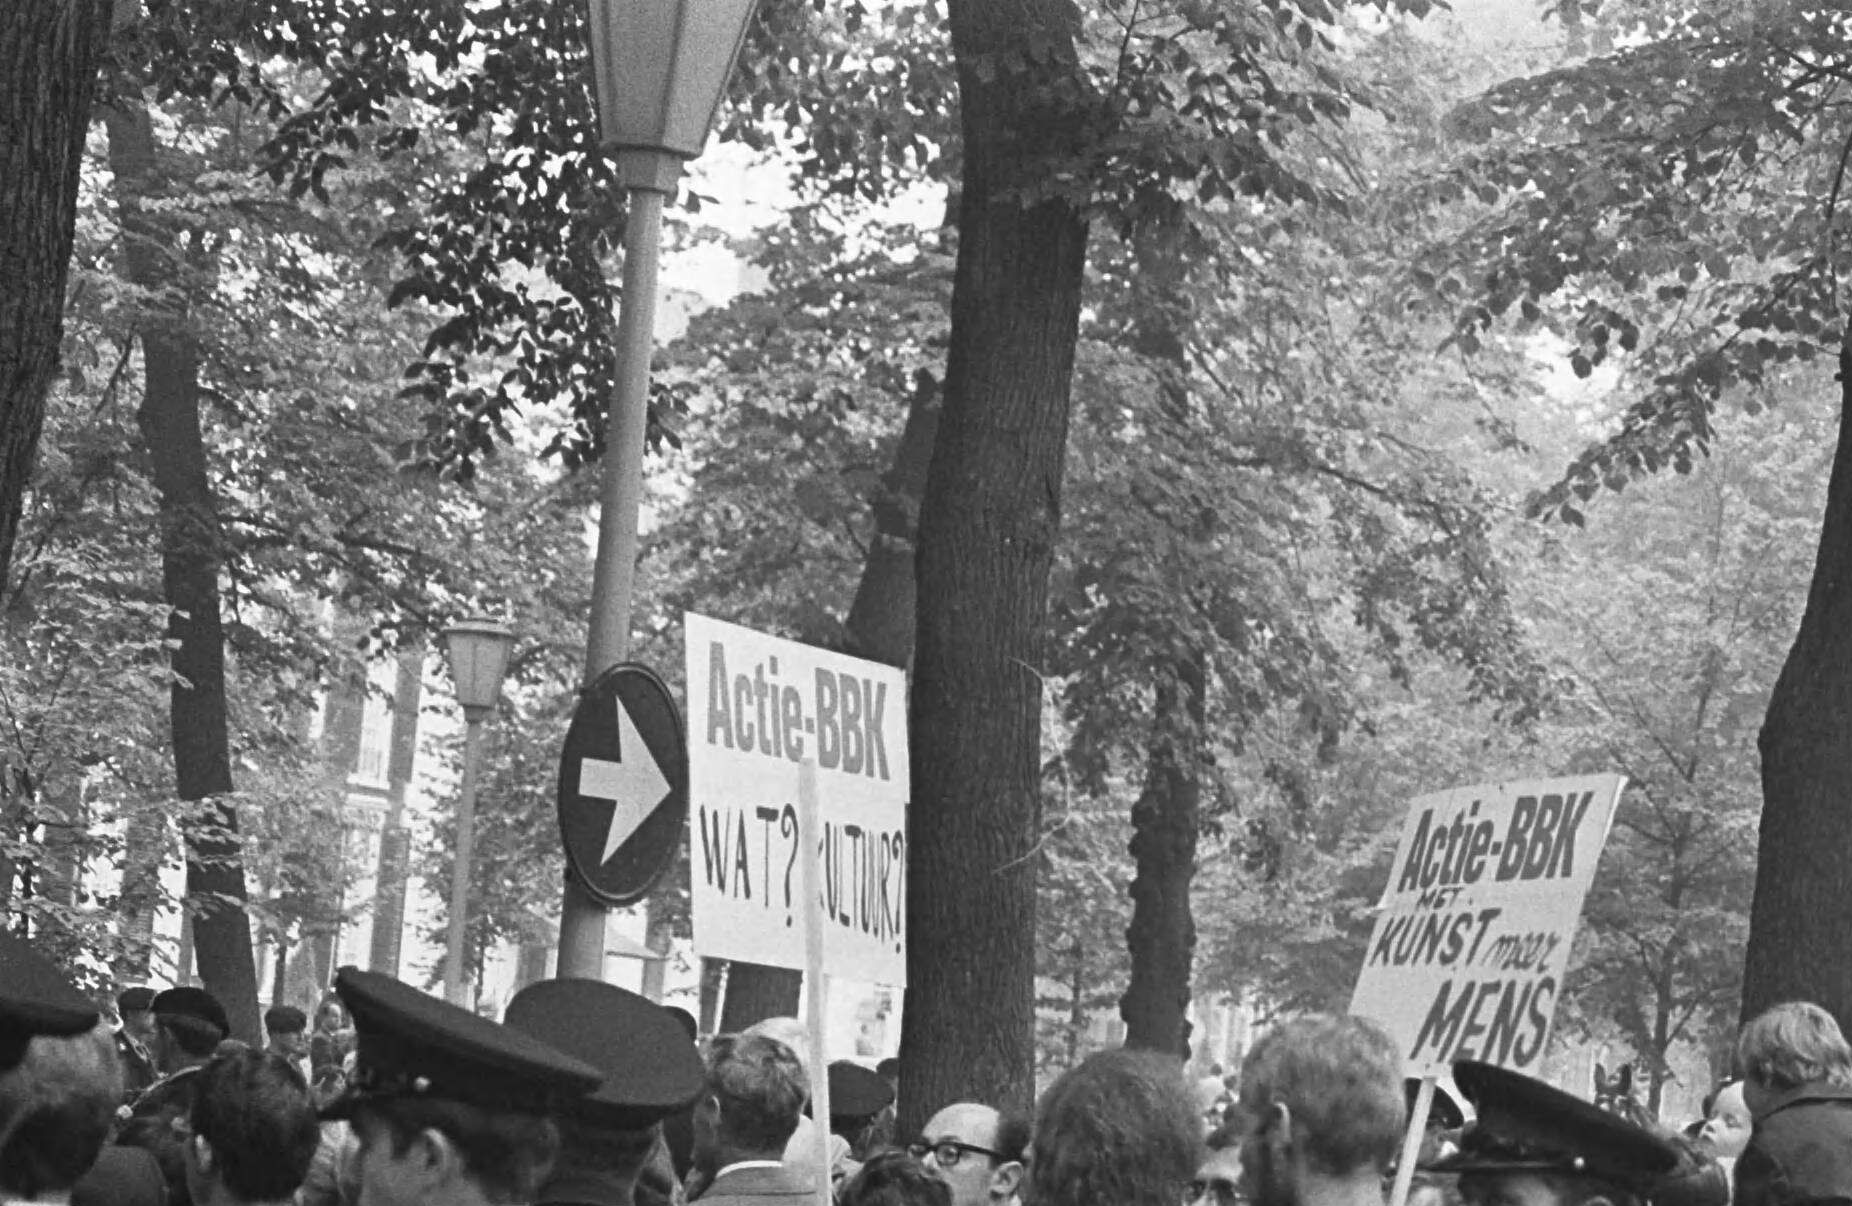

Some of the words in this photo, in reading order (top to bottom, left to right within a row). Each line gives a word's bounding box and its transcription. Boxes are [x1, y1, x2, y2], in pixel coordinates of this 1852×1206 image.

[707, 641, 890, 781] Actie-BBK
[699, 803, 800, 928] WAT?
[817, 821, 904, 954] ULTUUR?
[1397, 791, 1595, 893] Actie-BBK
[1368, 907, 1503, 968] KUNST
[1416, 887, 1465, 910] MET
[1409, 976, 1556, 1067] MENS
